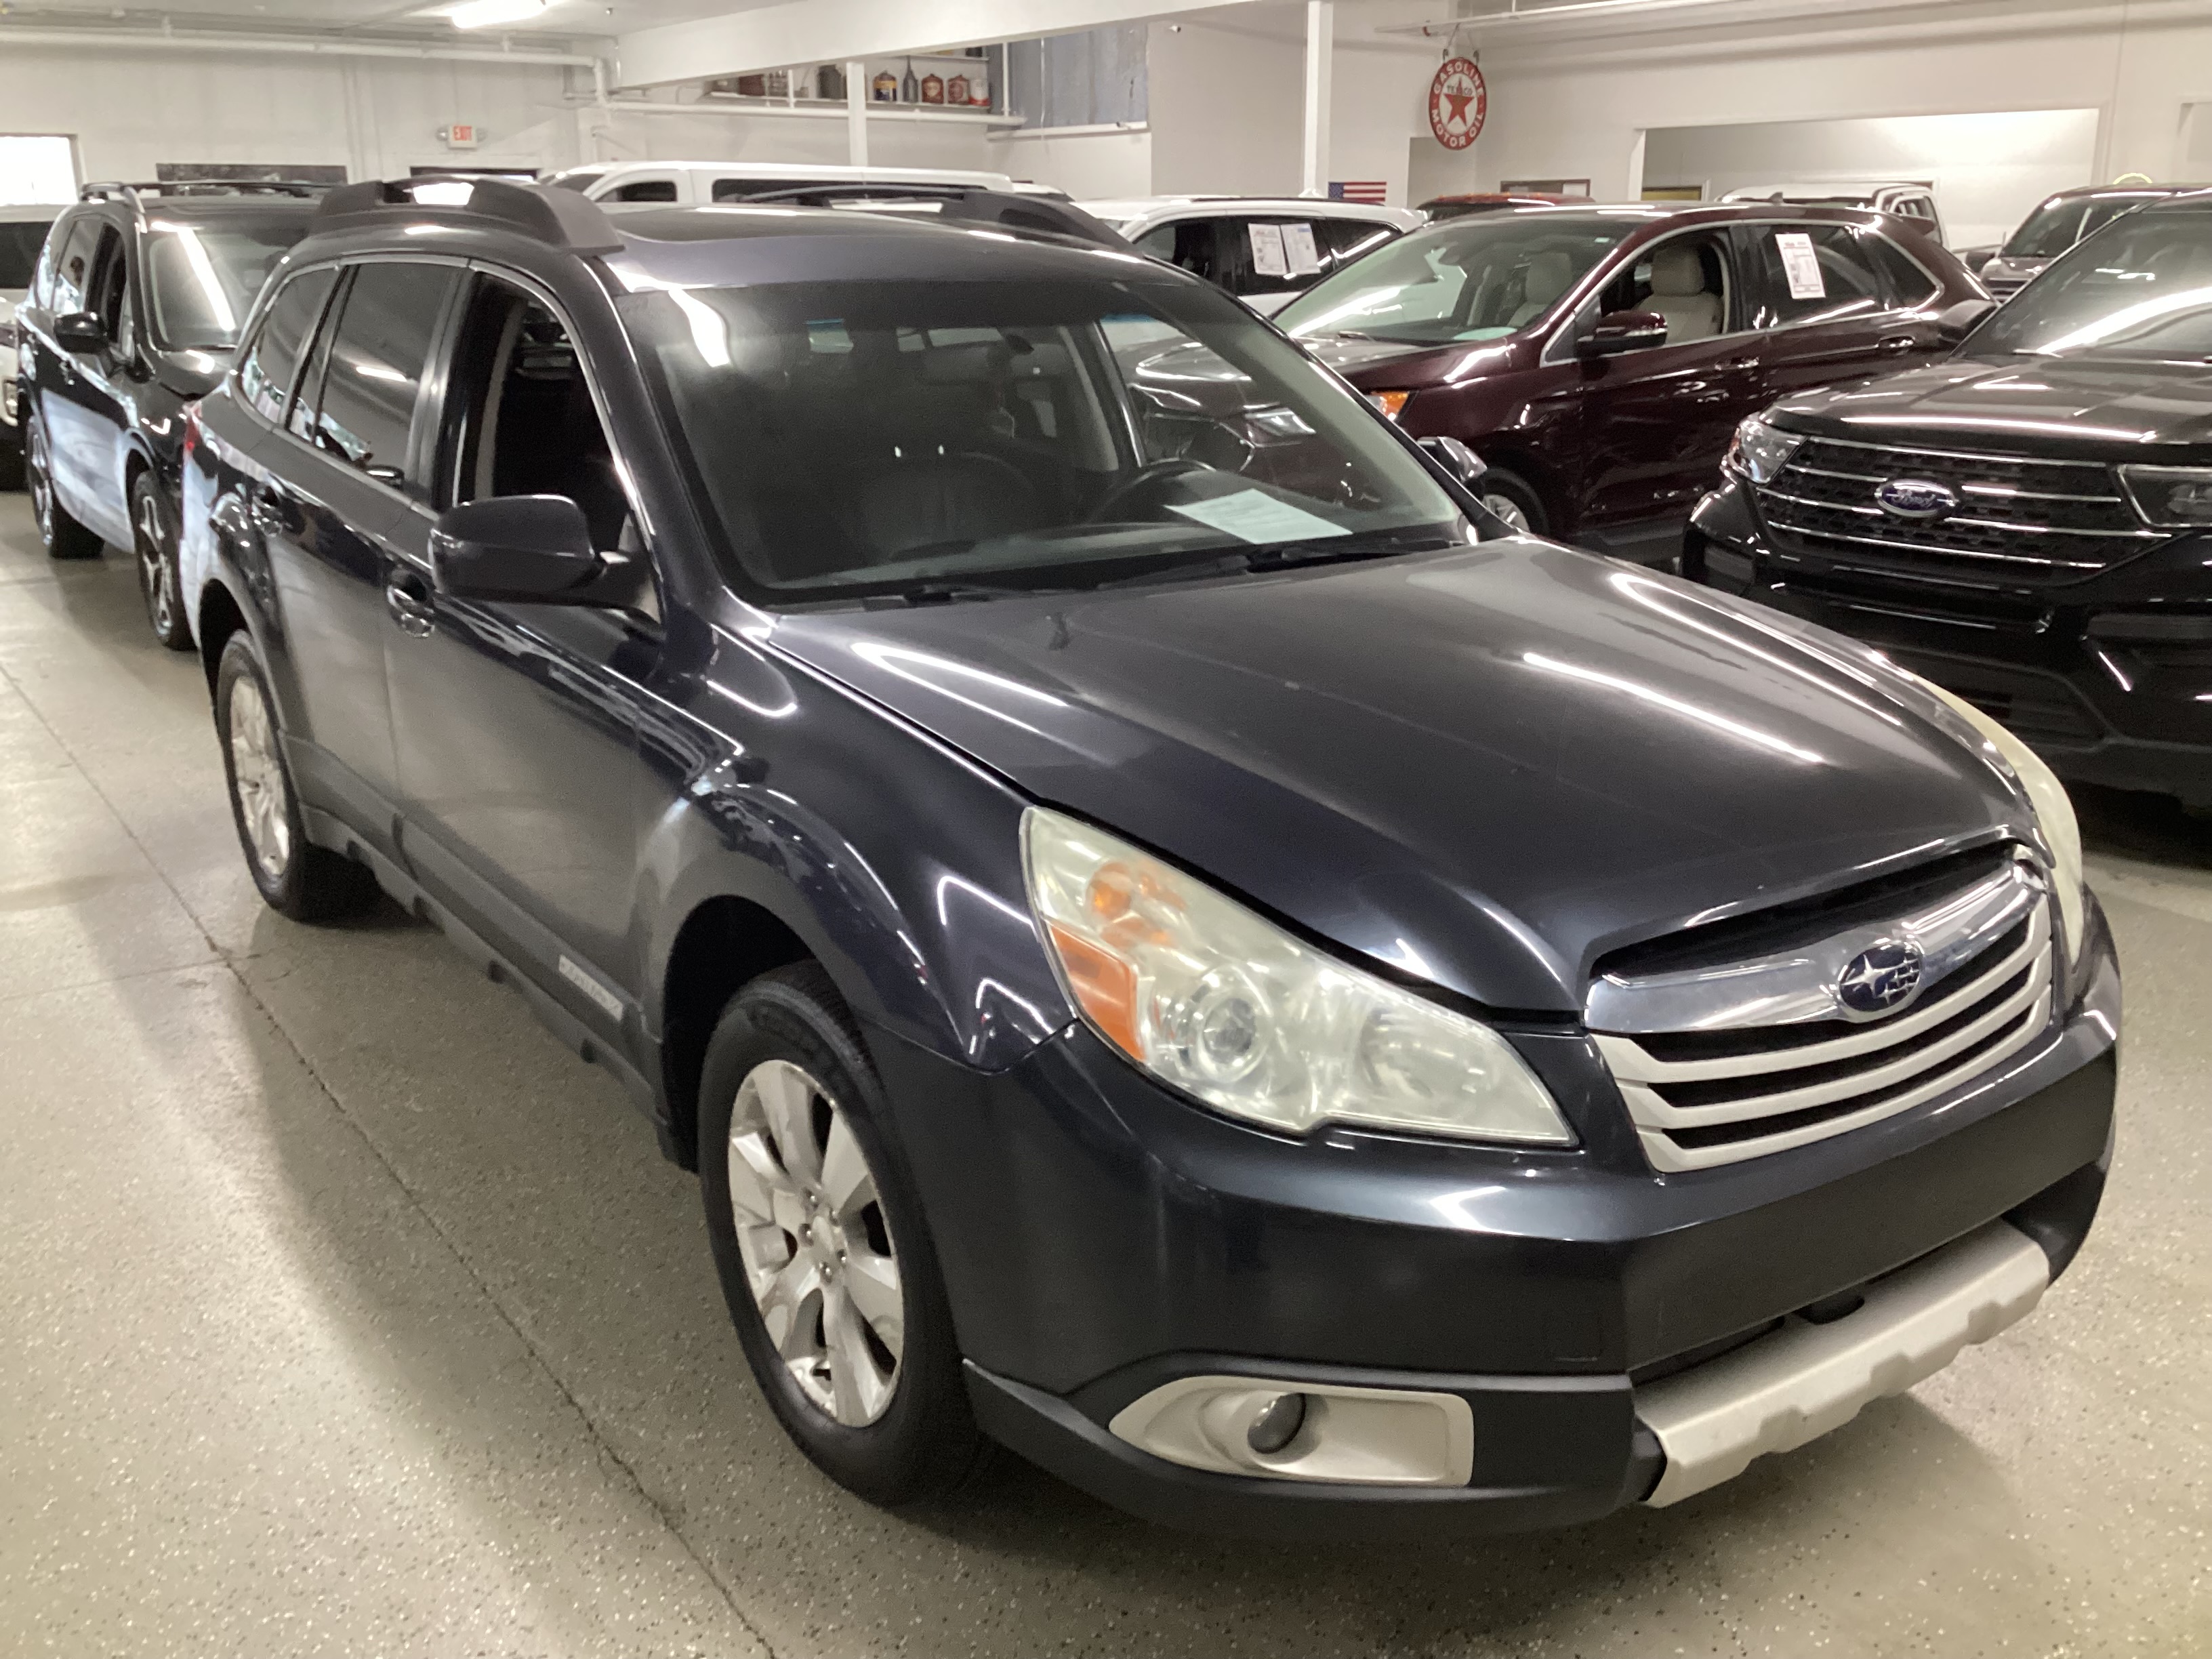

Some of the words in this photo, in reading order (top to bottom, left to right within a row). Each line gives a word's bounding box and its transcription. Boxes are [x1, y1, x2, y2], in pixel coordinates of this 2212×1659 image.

[1433, 61, 1483, 96] GASOLINE
[1447, 85, 1473, 95] TECO
[1431, 108, 1466, 146] MOTOR
[1469, 112, 1483, 138] OIL
[1891, 489, 1936, 508] Ford
